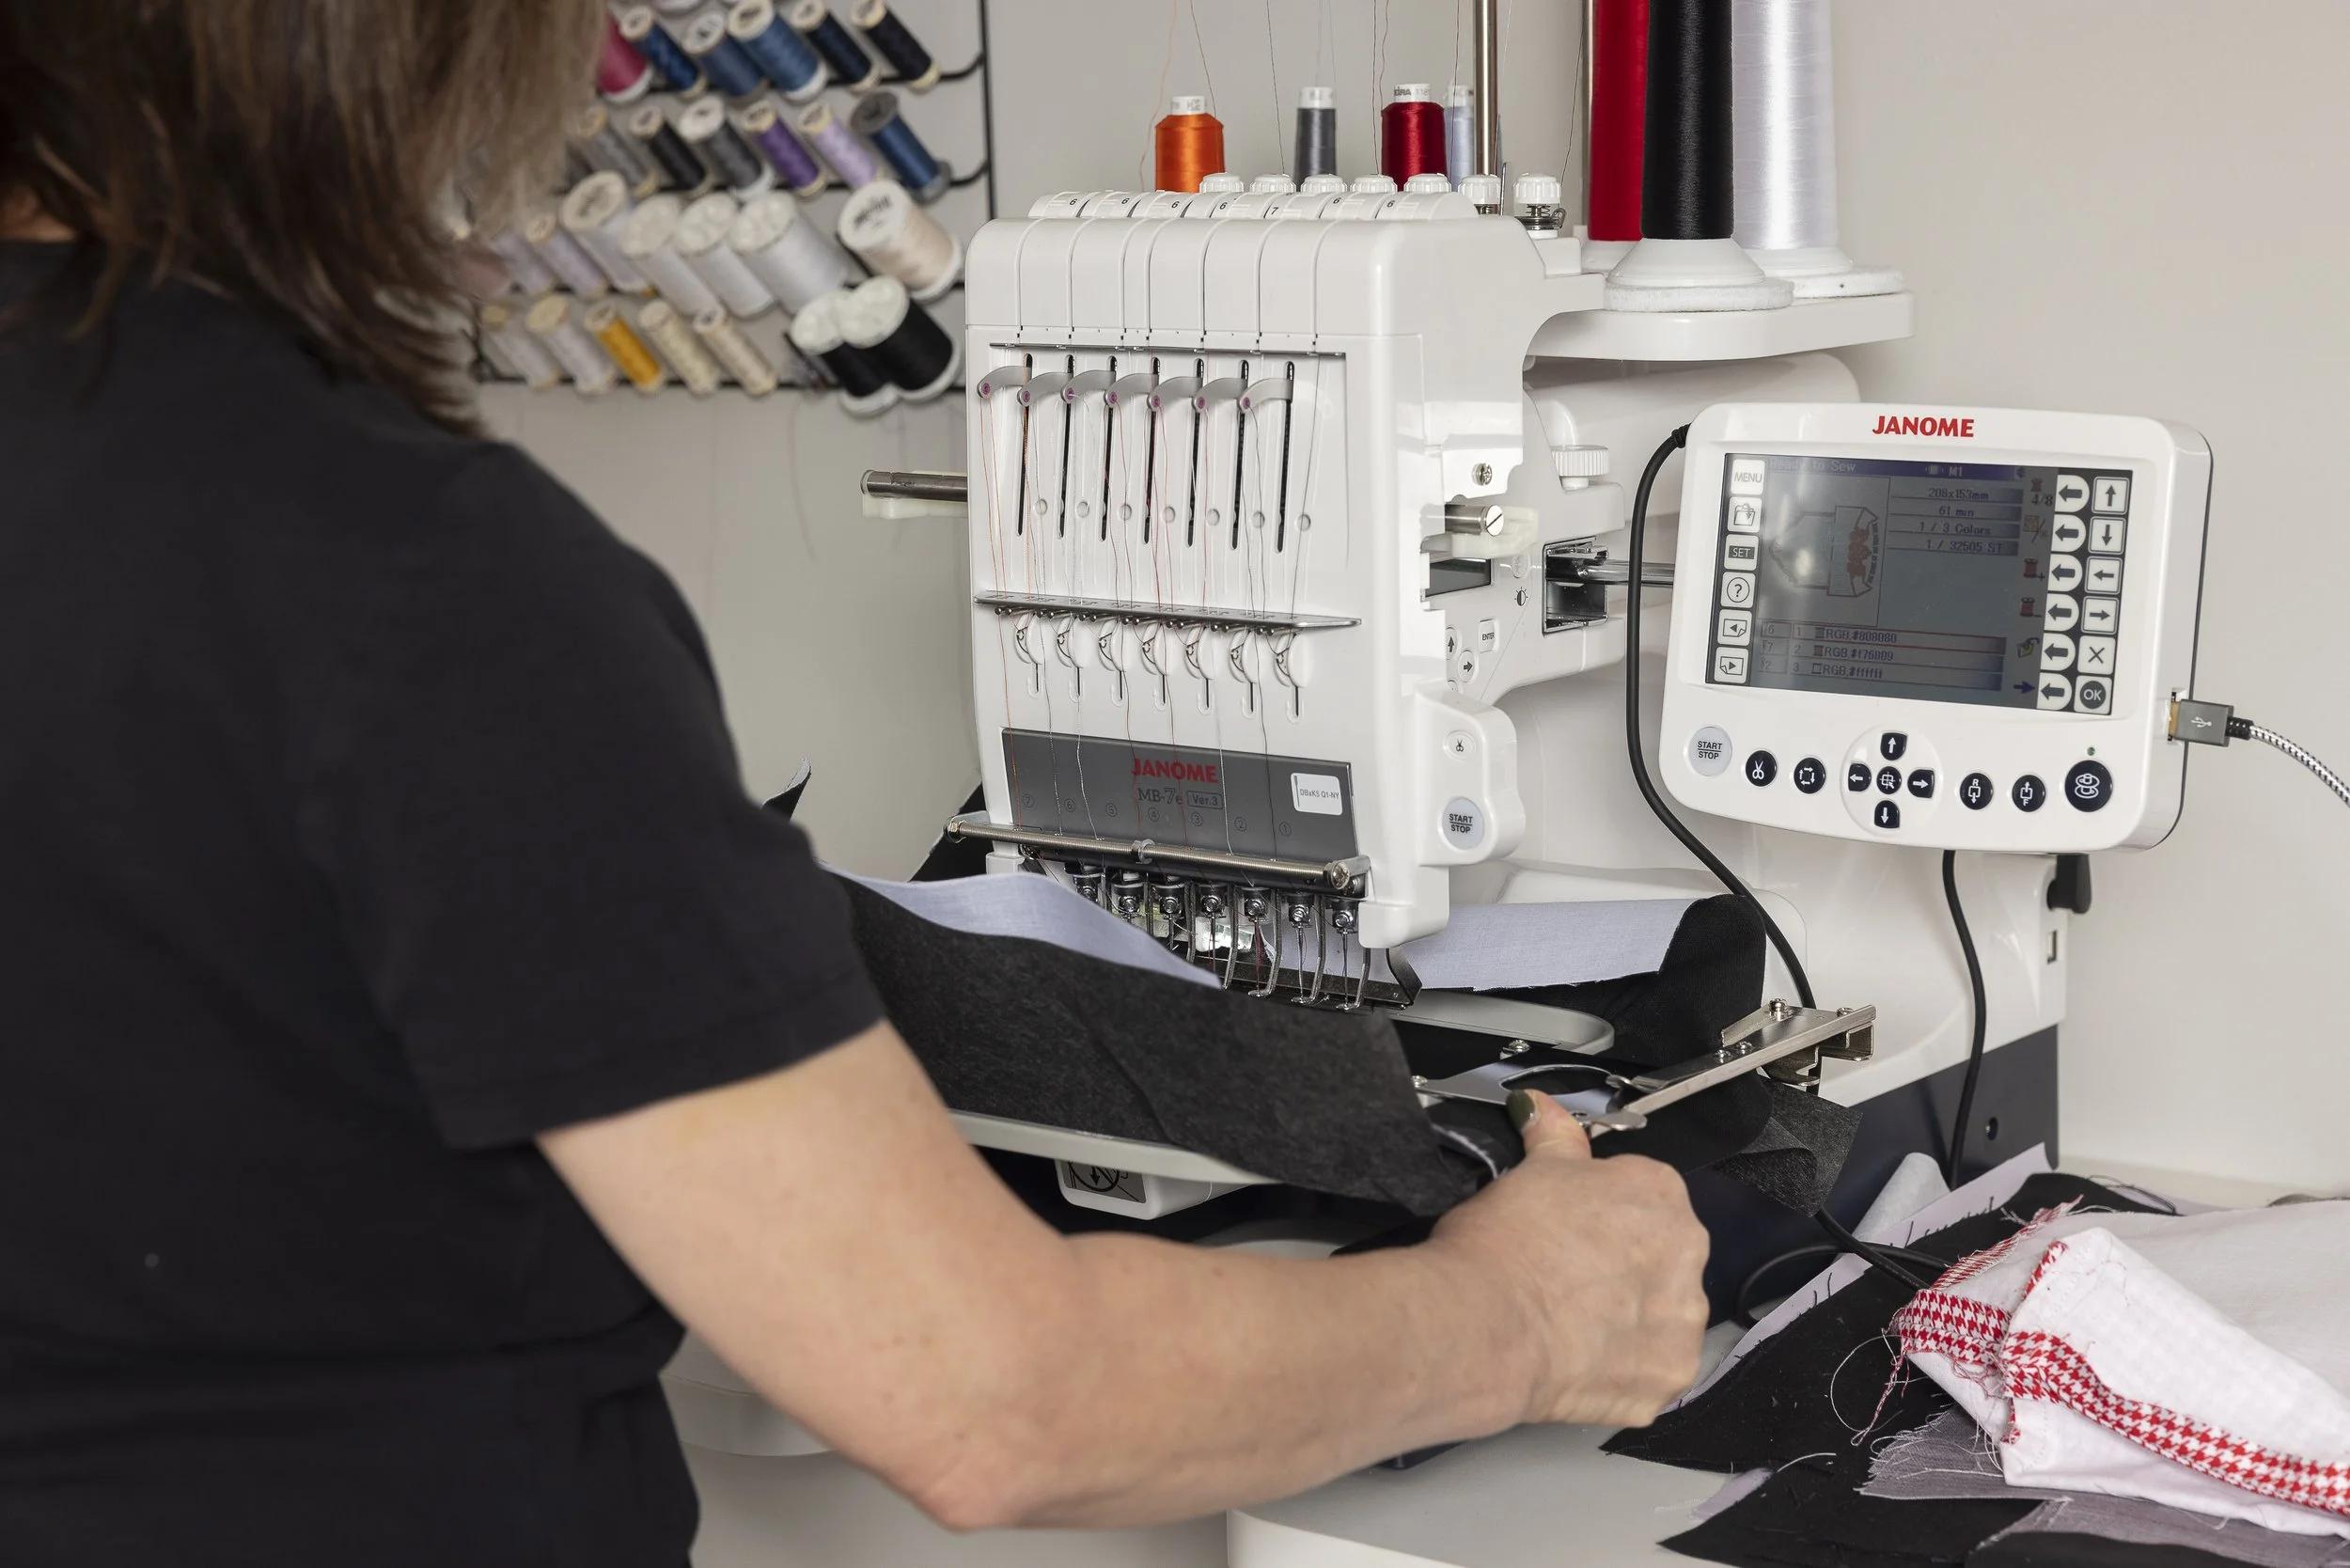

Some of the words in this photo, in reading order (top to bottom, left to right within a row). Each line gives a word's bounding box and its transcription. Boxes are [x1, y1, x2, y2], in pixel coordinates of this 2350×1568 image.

[1171, 200, 1180, 209] 6
[1219, 201, 1228, 210] 6
[1333, 196, 1341, 205] 6
[1386, 199, 1395, 208] 6
[1271, 206, 1278, 215] 7
[1872, 416, 1974, 437] JANOME
[1813, 461, 1825, 470] to
[1831, 460, 1856, 472] Sew
[1949, 466, 1963, 477] M1
[1734, 473, 1762, 483] MENU
[1929, 487, 1988, 501] 208x153mm
[2031, 493, 2053, 507] 4/8
[1939, 506, 1950, 515] 61
[1956, 508, 1974, 517] min
[1919, 521, 1924, 532] 1
[1943, 523, 1950, 533] 3
[1955, 524, 1991, 535] Colors
[1927, 539, 1932, 550] 1
[1950, 541, 1983, 553] 32505
[1987, 542, 2004, 554] ST
[1732, 548, 1750, 557] SET
[1482, 632, 1495, 640] ENTER
[1794, 644, 1801, 654] 2
[1793, 662, 1799, 673] 3
[2083, 689, 2102, 702] OK
[1698, 741, 1722, 749] START
[1132, 758, 1218, 784] JANOME
[1138, 787, 1183, 805] MB-7e
[1192, 793, 1218, 806] Ver.3
[2023, 798, 2029, 807] F
[1449, 813, 1473, 823] START
[1450, 823, 1471, 834] STOP
